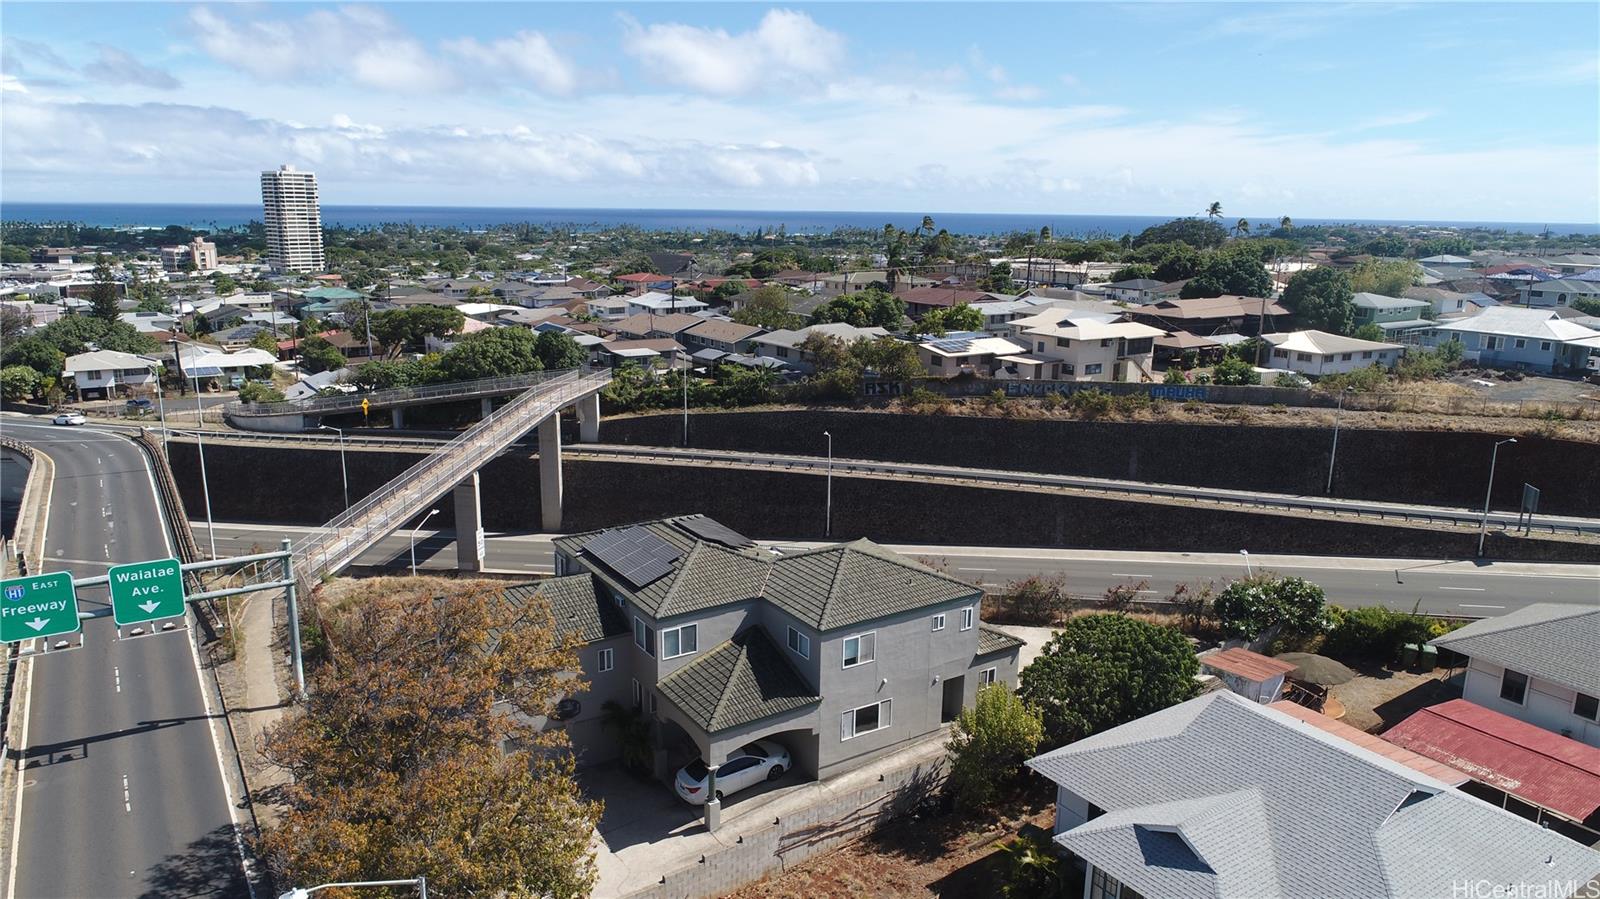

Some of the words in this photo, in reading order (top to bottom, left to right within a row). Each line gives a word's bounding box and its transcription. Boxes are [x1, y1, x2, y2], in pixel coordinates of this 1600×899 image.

[117, 566, 175, 583] Waialae
[32, 580, 59, 591] EAST
[132, 584, 164, 597] Ave.
[2, 600, 67, 617] Freeway
